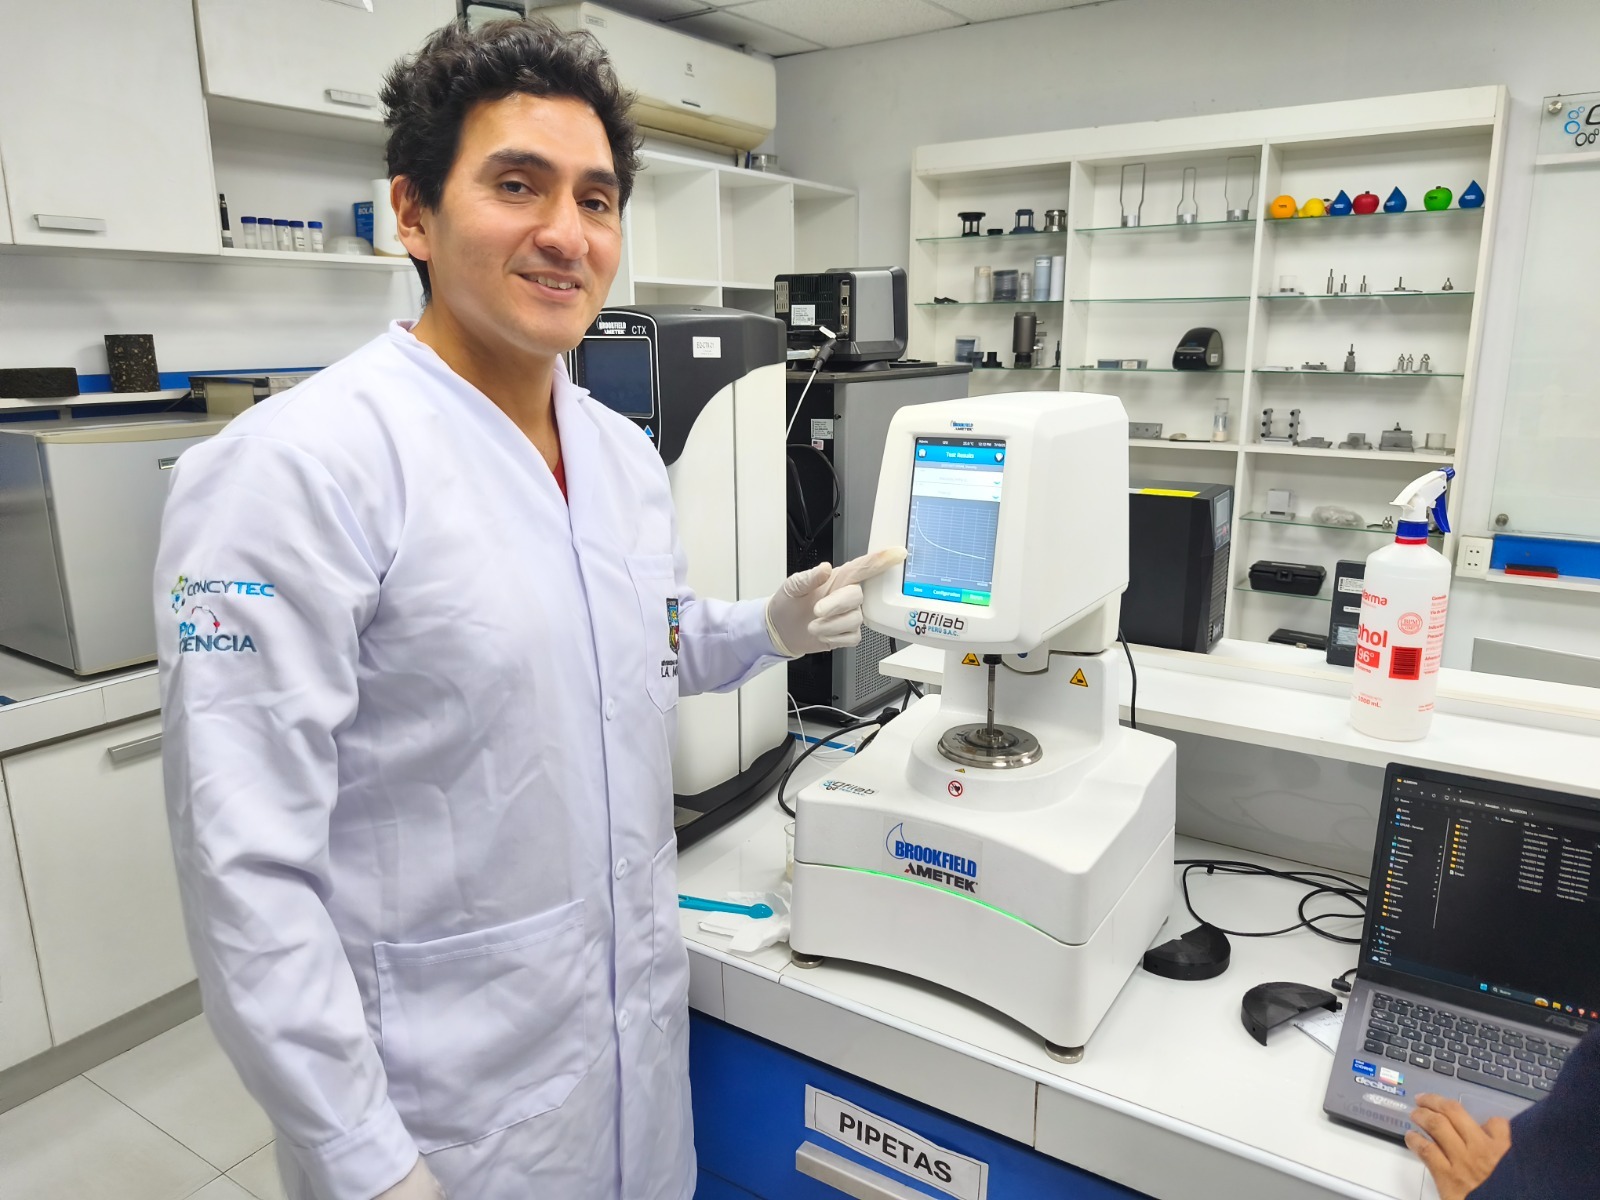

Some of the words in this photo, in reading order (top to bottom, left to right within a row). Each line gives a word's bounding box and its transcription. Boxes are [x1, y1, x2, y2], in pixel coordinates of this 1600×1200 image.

[631, 325, 647, 335] CTX
[187, 579, 275, 597] CONCYTEC
[917, 611, 965, 631] Ofilab
[1358, 649, 1375, 663] 96°
[832, 781, 875, 795] Ofilab
[895, 840, 977, 879] BROOKFIELD
[904, 862, 978, 894] AMETEK
[839, 1111, 952, 1183] PIPETAS
